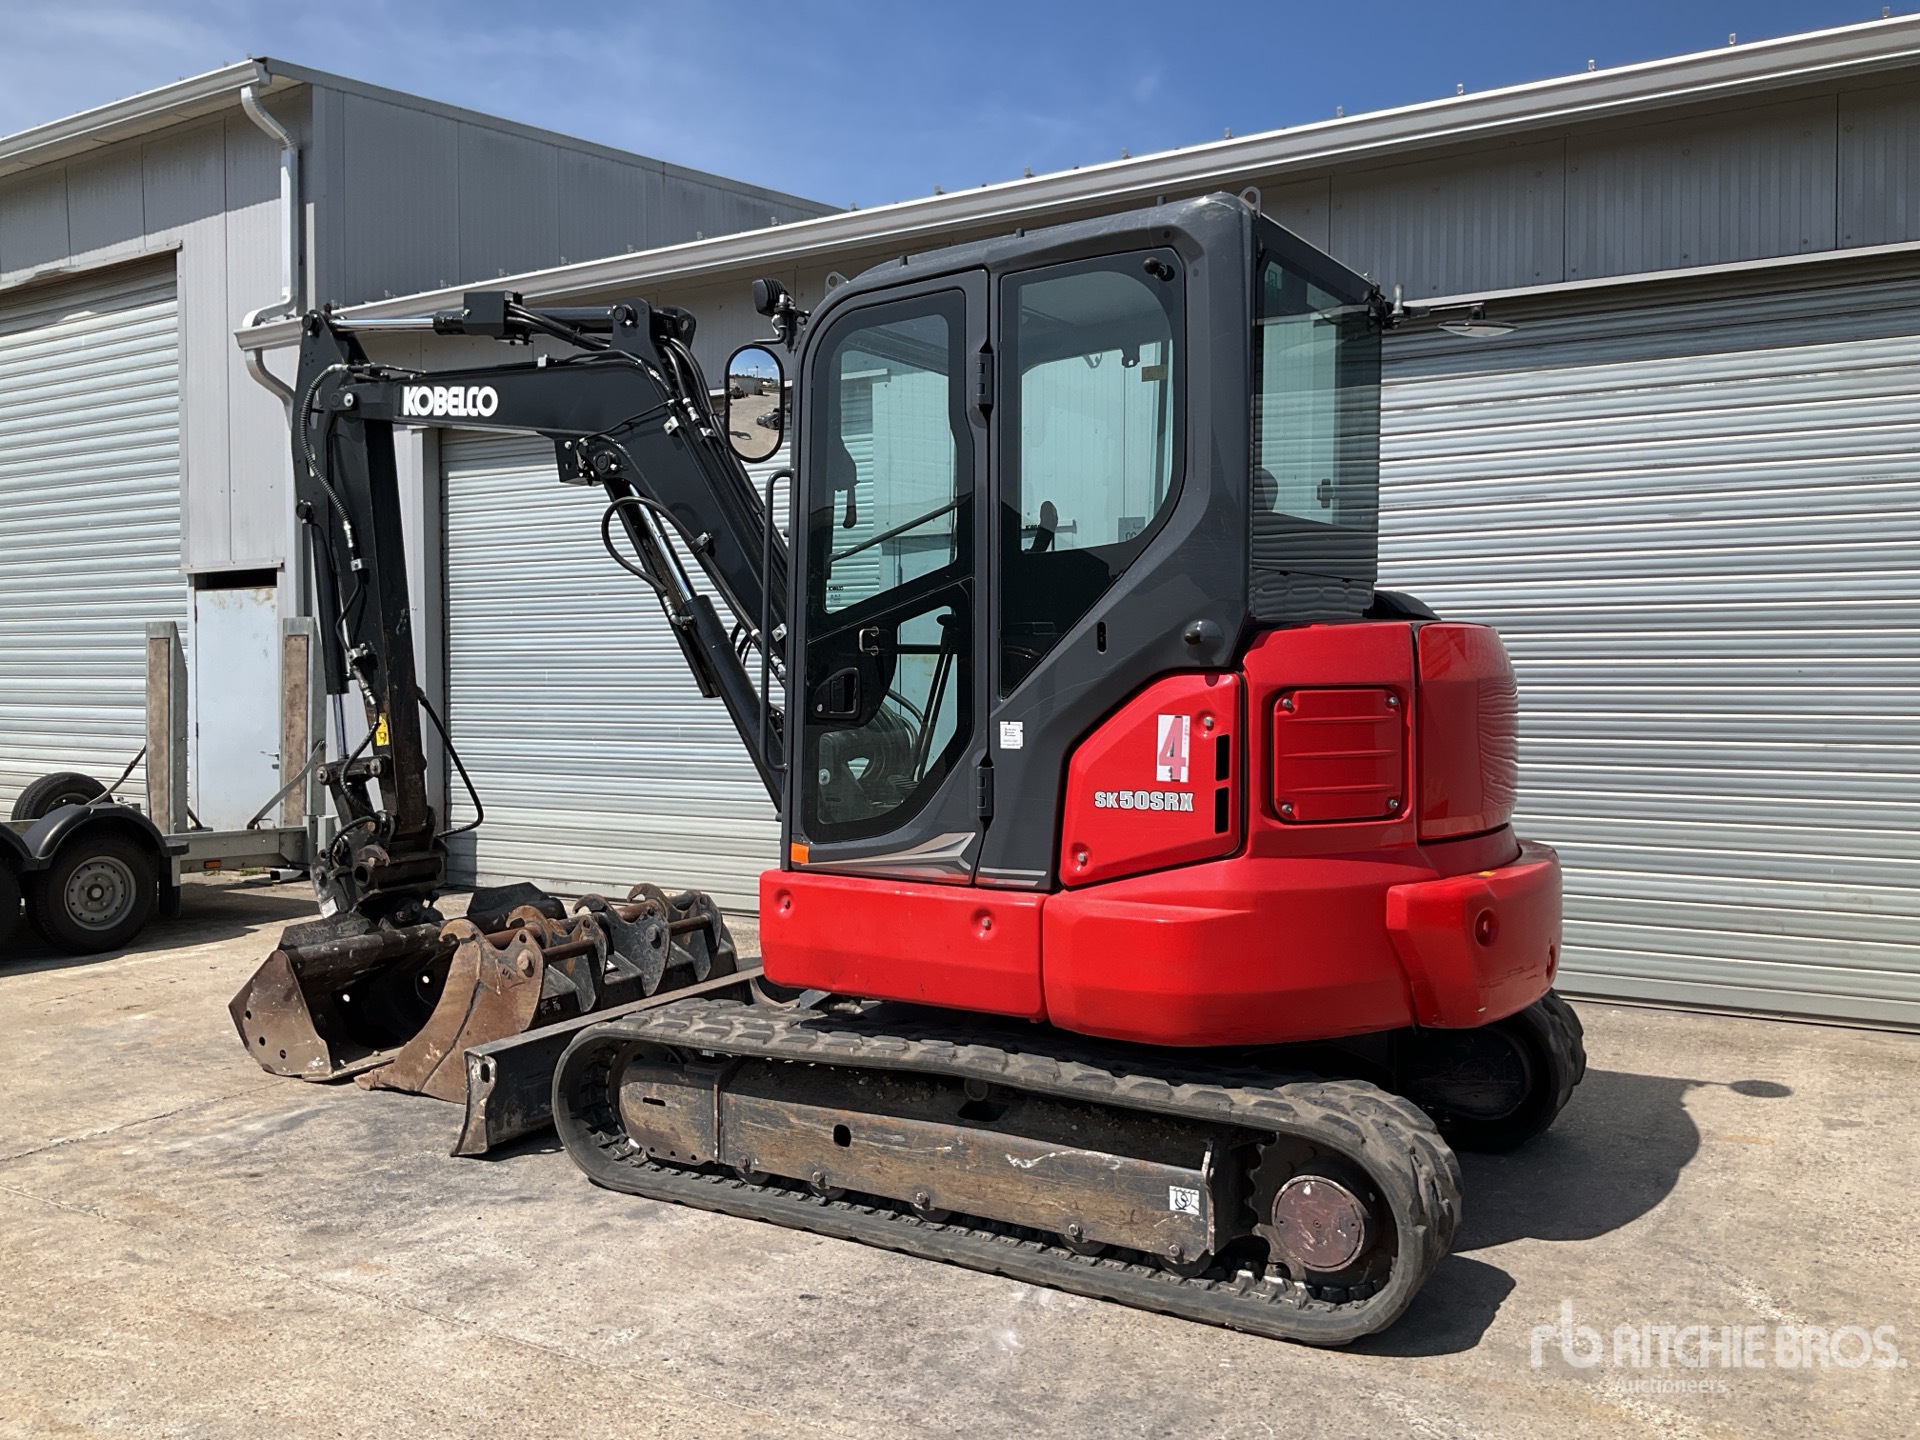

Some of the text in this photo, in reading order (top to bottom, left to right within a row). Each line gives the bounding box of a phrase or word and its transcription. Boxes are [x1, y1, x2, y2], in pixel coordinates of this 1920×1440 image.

[403, 386, 498, 417] KOBELCO
[1158, 715, 1187, 781] 4
[1094, 790, 1194, 812] SK50SRX
